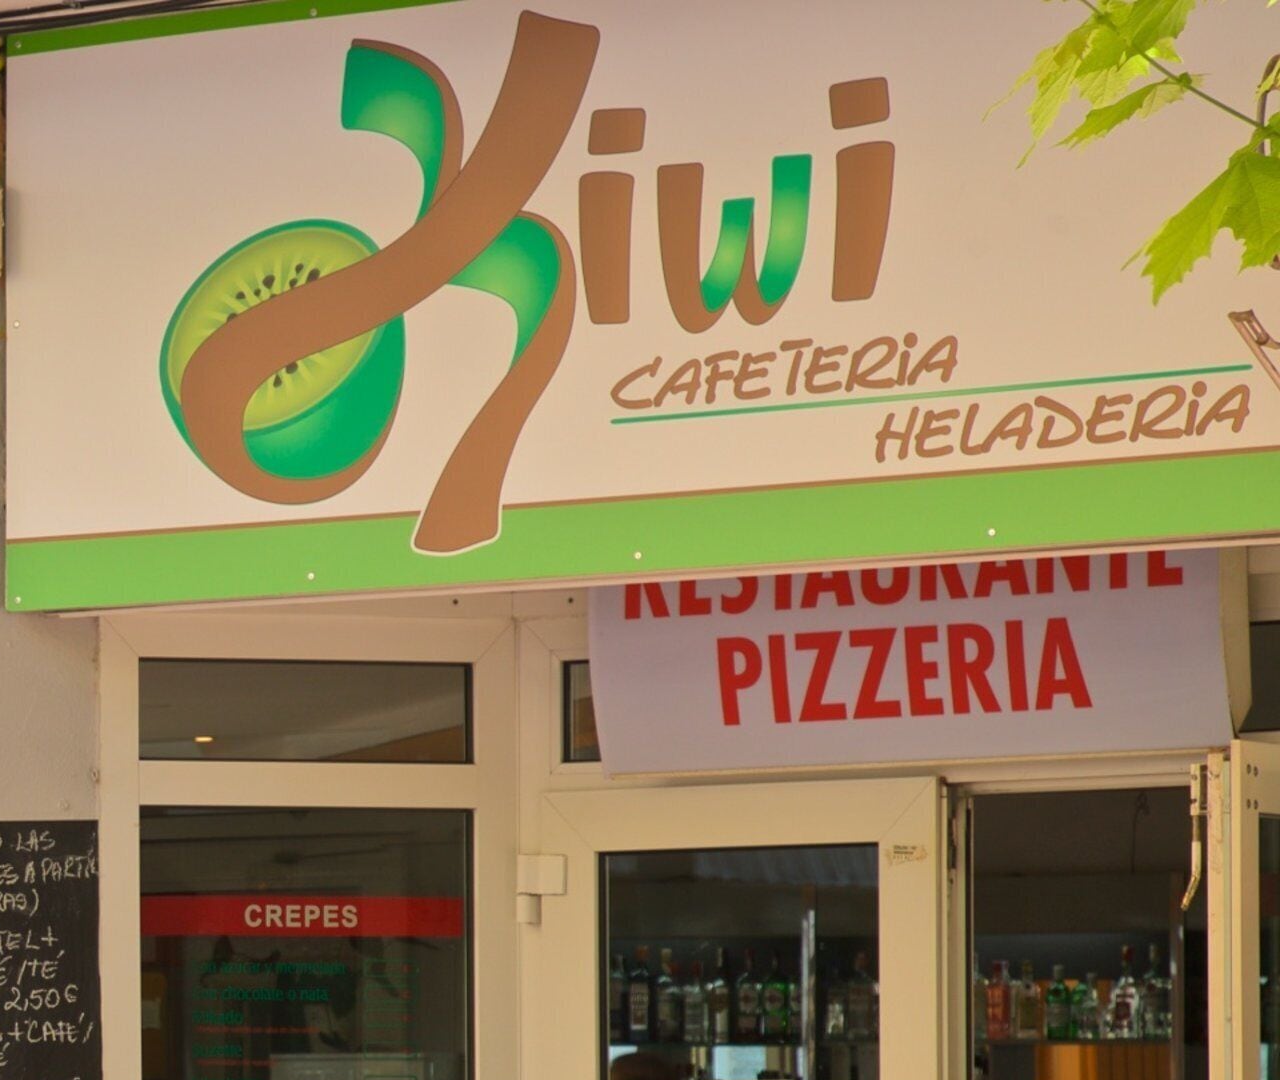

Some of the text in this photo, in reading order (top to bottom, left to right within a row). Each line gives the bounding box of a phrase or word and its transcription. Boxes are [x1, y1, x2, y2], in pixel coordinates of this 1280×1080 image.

[160, 10, 895, 556] Kiwi
[716, 616, 1093, 726] PIZZERIA
[16, 829, 56, 851] LAS
[24, 861, 36, 883] A
[243, 903, 359, 928] CREPES
